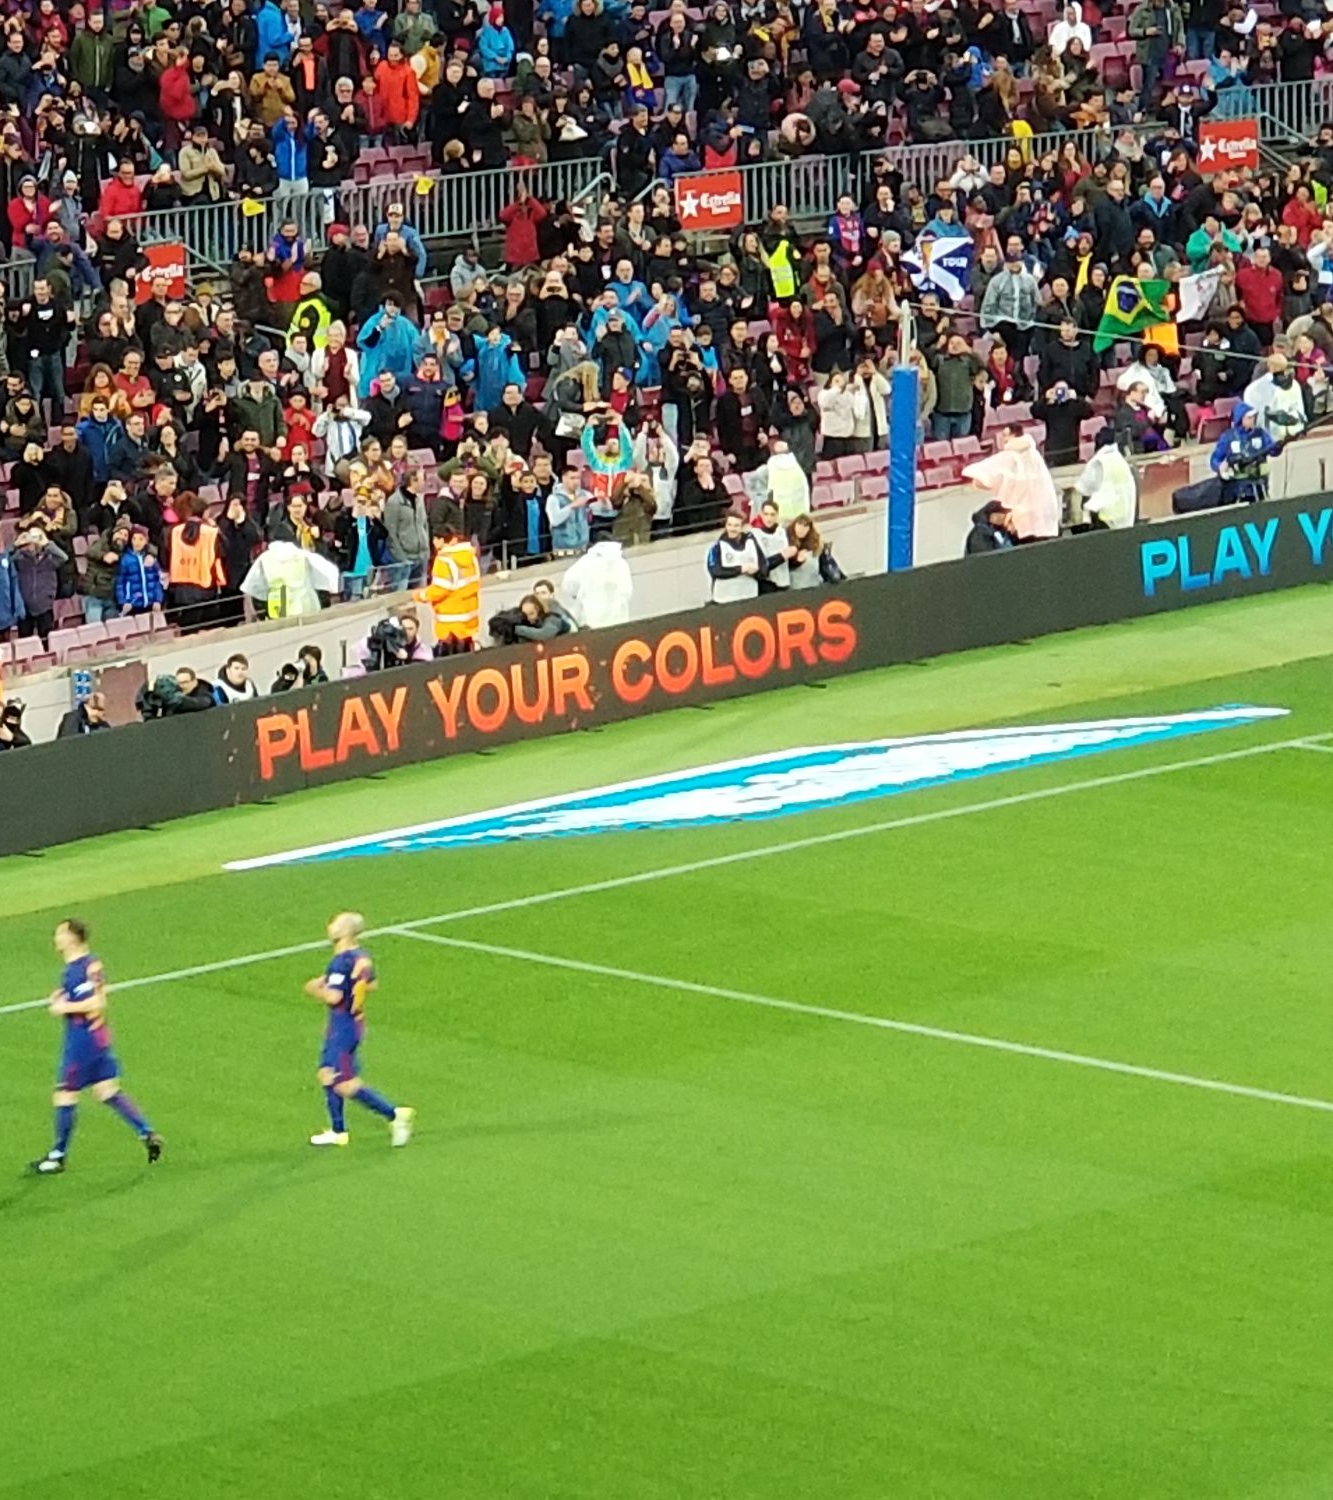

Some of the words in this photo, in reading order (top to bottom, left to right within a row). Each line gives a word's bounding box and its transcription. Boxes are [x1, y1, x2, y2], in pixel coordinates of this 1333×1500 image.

[1141, 517, 1279, 596] PLAY
[1297, 508, 1333, 565] Y
[255, 687, 407, 780] PLAY
[427, 652, 595, 739] YOUR
[611, 600, 857, 703] COLORS
